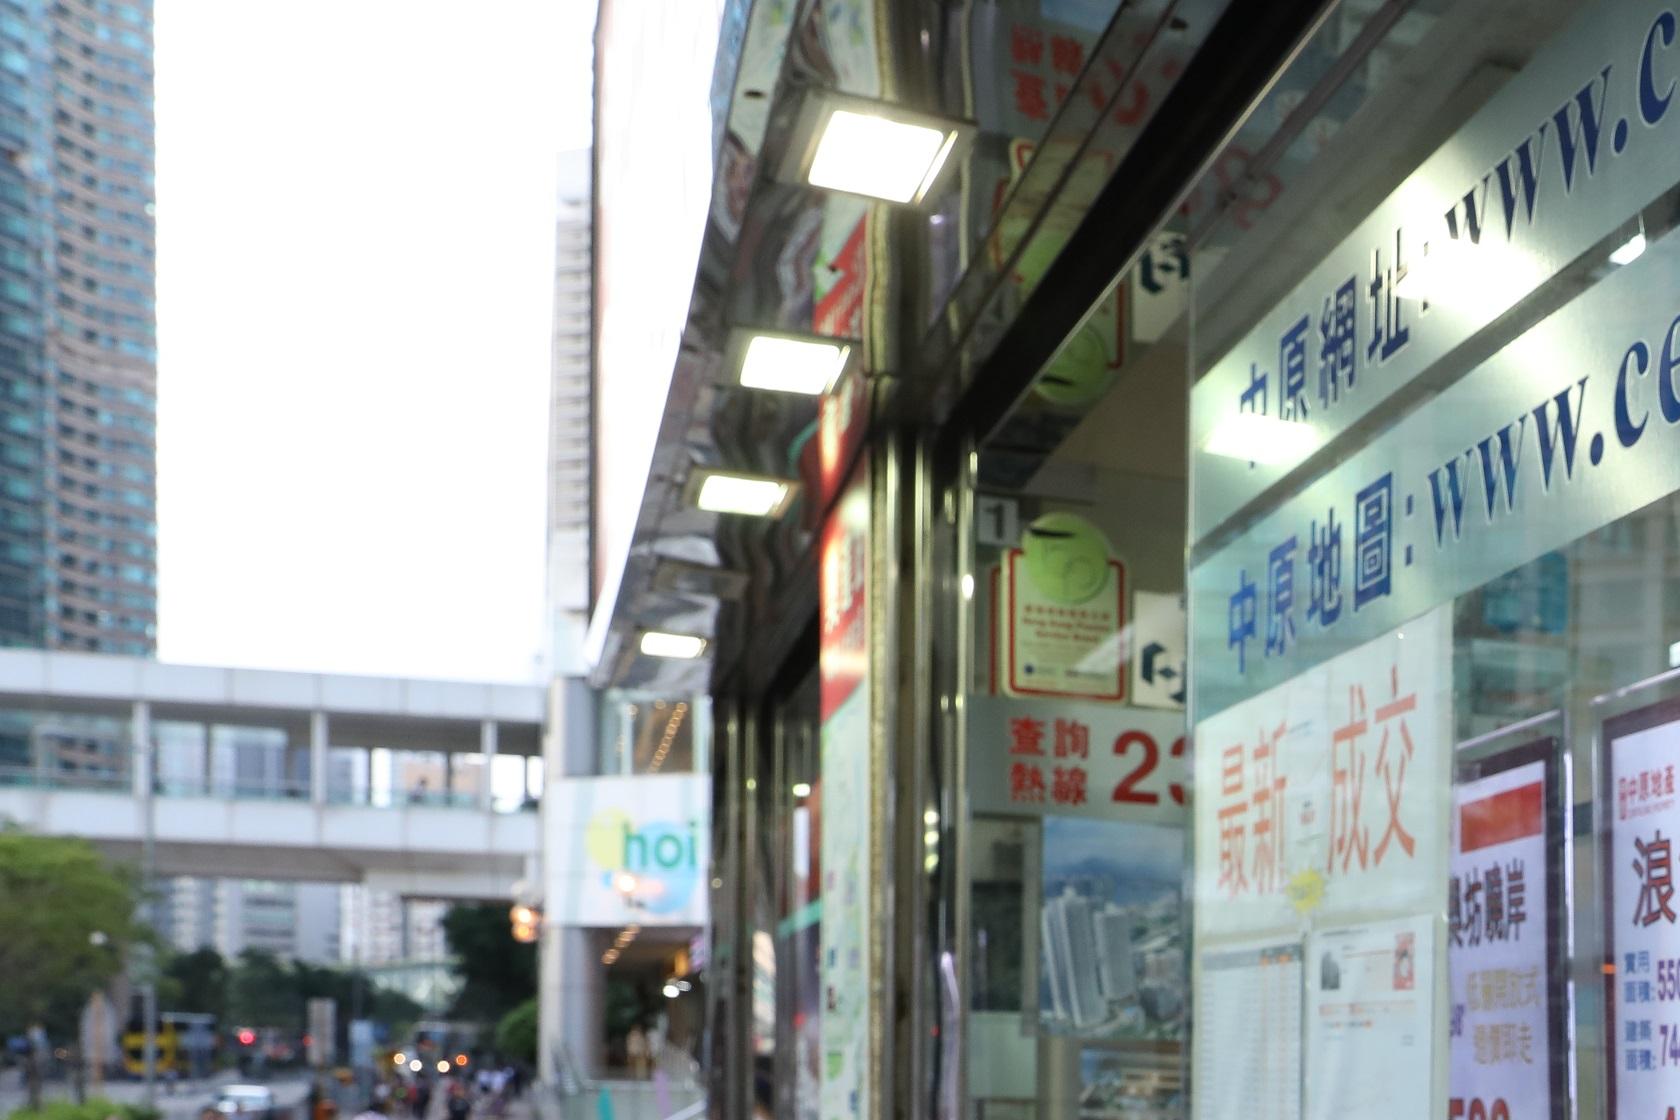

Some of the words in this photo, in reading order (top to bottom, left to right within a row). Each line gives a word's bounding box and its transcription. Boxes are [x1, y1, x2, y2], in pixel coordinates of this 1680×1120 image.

[1227, 472, 1413, 672] 中原地圖:
[1327, 663, 1417, 876] 成交
